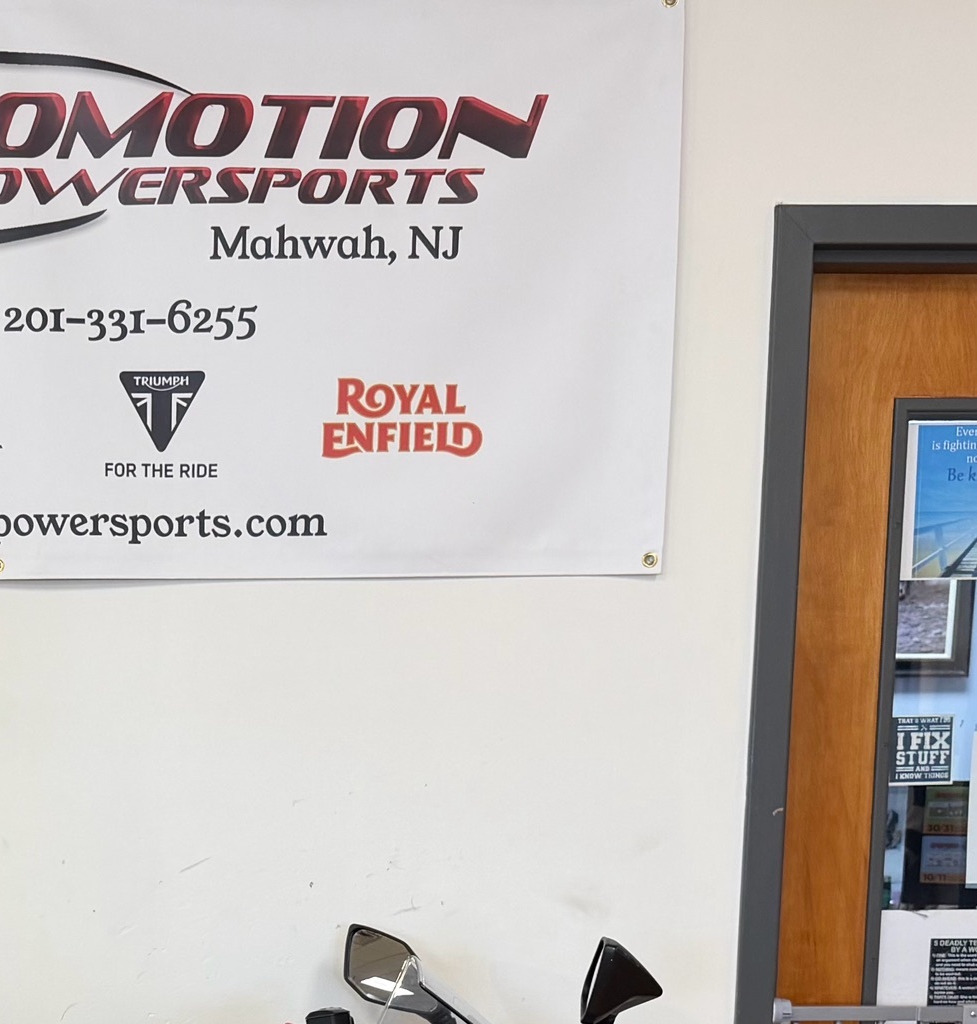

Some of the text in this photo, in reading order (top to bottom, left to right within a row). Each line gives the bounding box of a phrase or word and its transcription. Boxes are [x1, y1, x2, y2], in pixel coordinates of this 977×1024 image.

[210, 224, 463, 263] Mahwah, NJ
[4, 300, 258, 341] 201-331-6255
[133, 376, 189, 387] TRIUMPH
[337, 378, 466, 418] ROYAL
[321, 421, 483, 459] ENFIELD
[932, 440, 940, 450] is
[104, 462, 218, 478] FOR THE RIDE
[948, 468, 963, 481] Be
[896, 732, 951, 750] I FIX
[895, 750, 950, 765] STUFF
